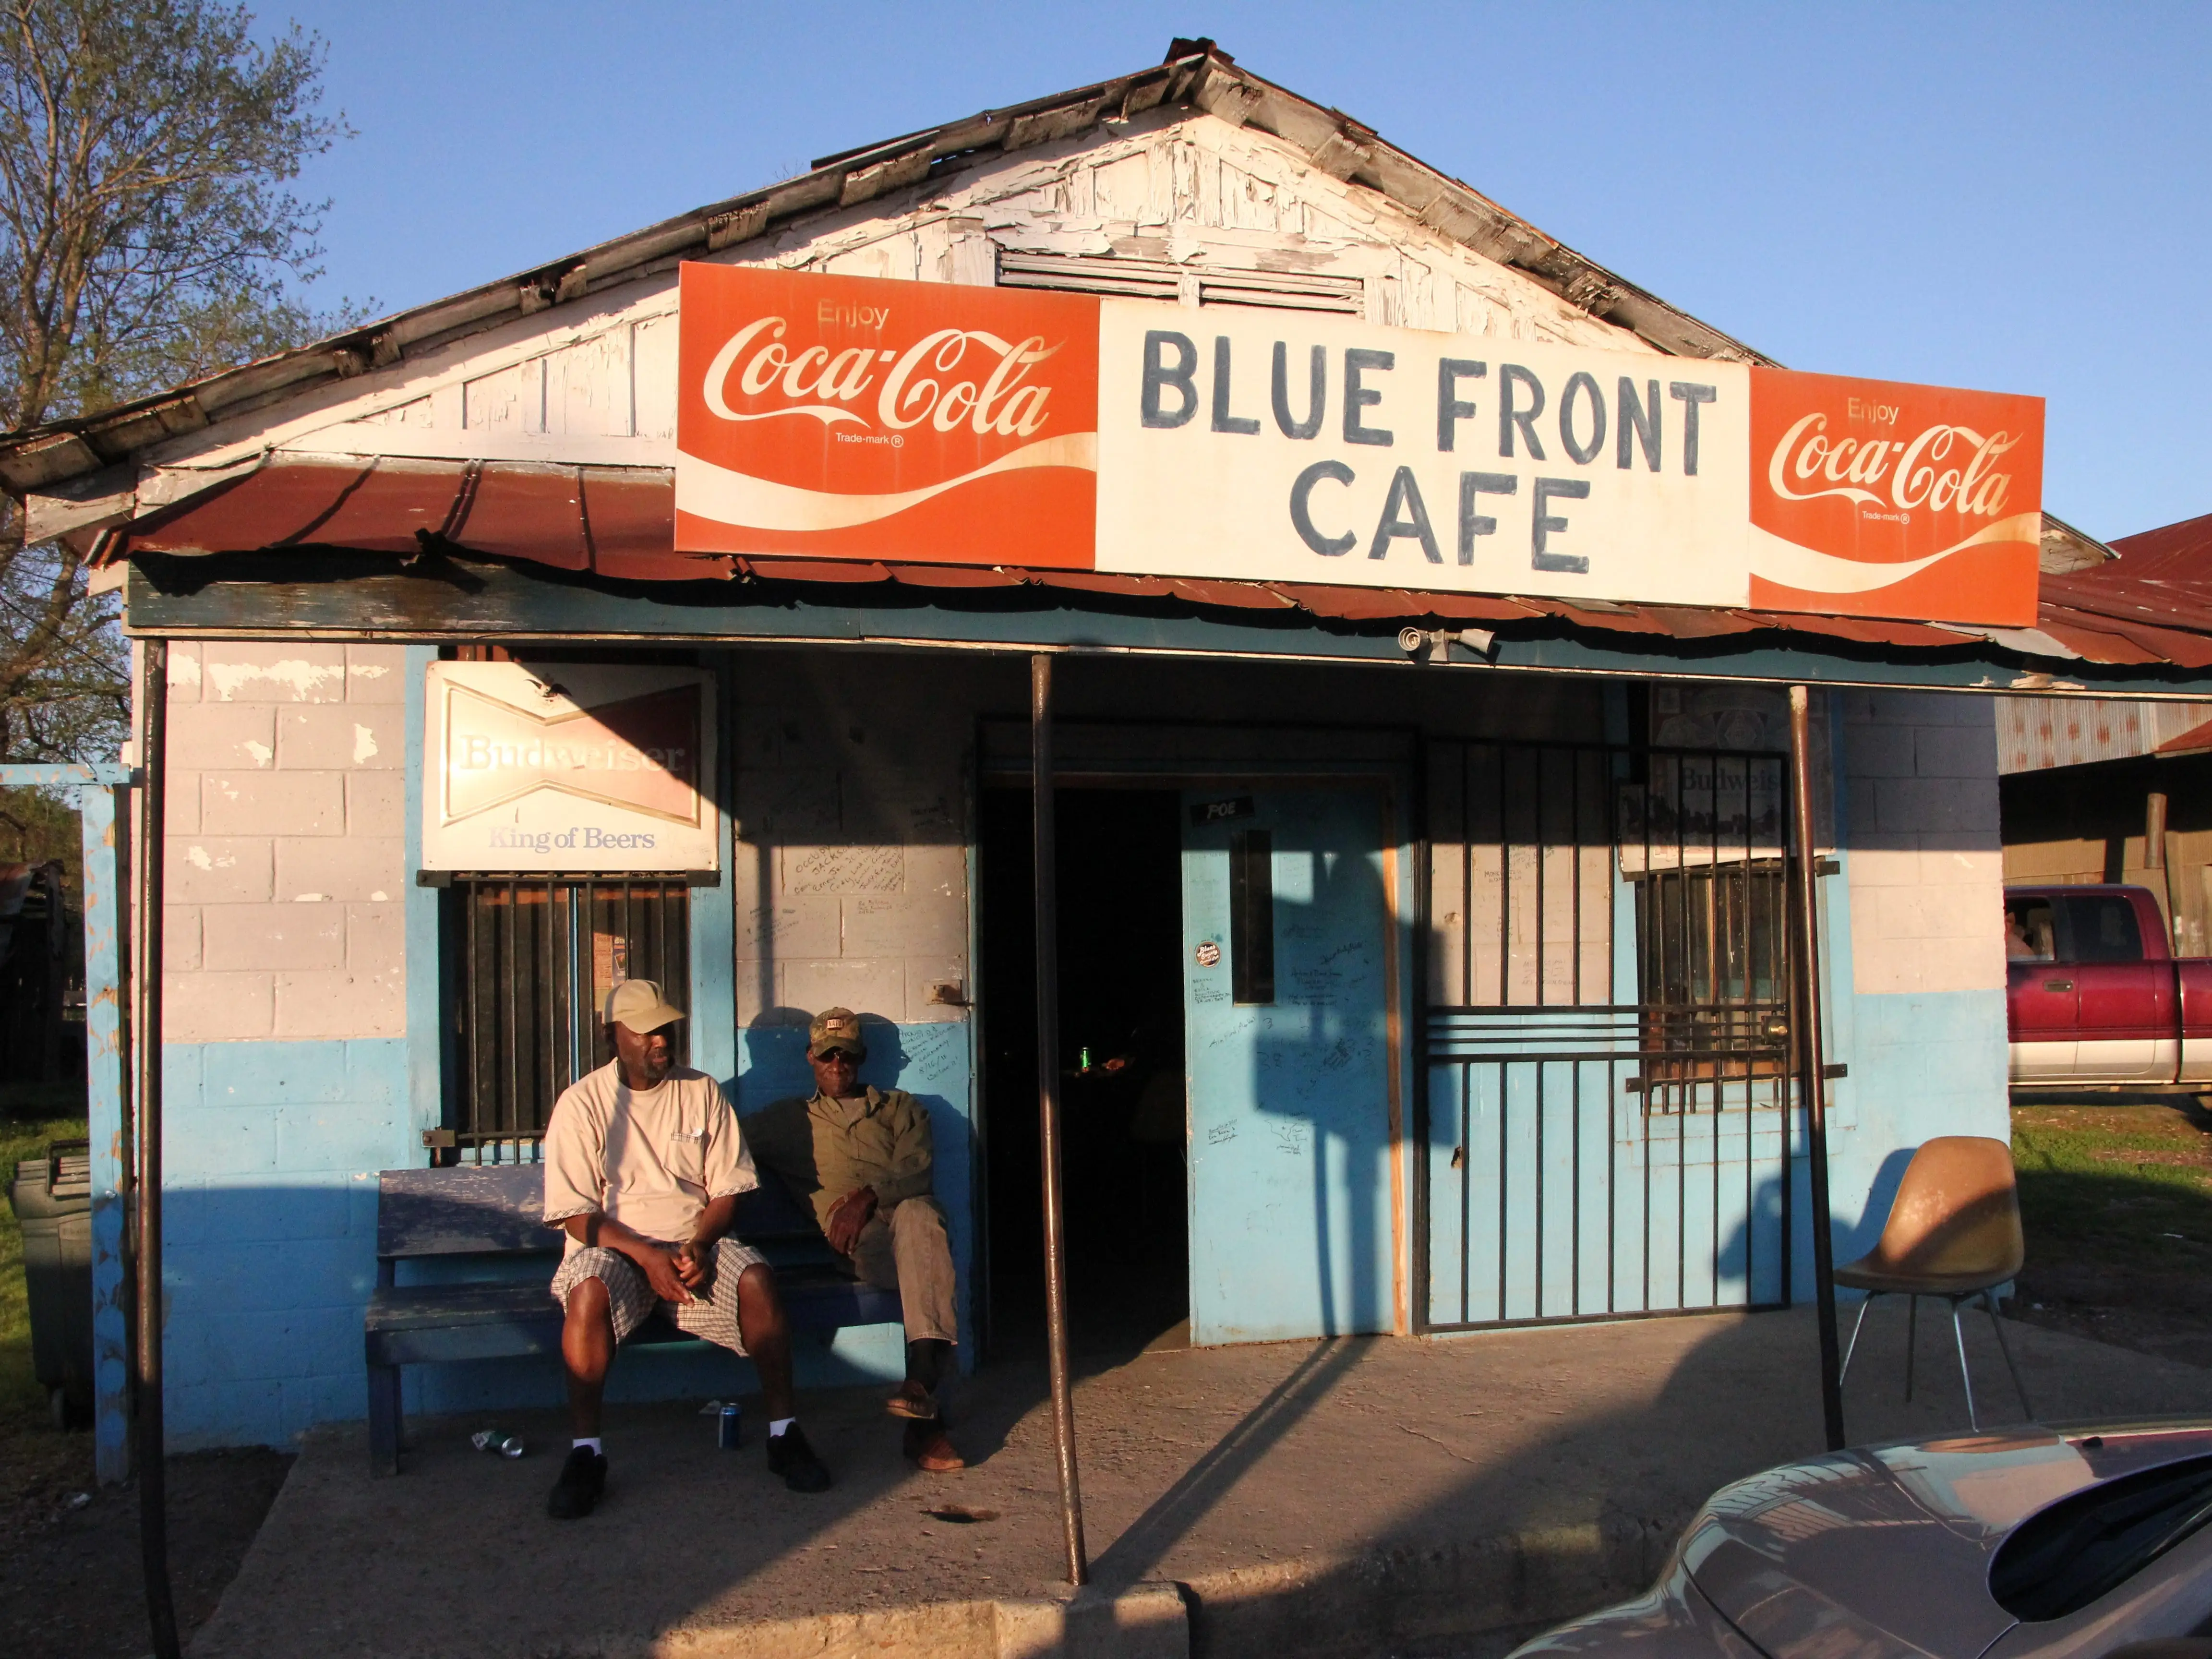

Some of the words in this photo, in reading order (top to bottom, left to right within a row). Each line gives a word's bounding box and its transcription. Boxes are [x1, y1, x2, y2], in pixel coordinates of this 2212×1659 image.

[817, 299, 889, 330] Enjoy
[704, 315, 1067, 437] Coca-Cola
[1141, 330, 1395, 446] BLUE
[1437, 357, 1717, 476] FRONT
[1848, 397, 1899, 425] Enjoy
[1769, 412, 2023, 516] Coca-Cola
[1290, 459, 1590, 574] CAFE
[459, 734, 686, 772] Budweiser
[489, 827, 551, 854] King
[554, 827, 579, 849] of
[583, 828, 655, 849] Beers
